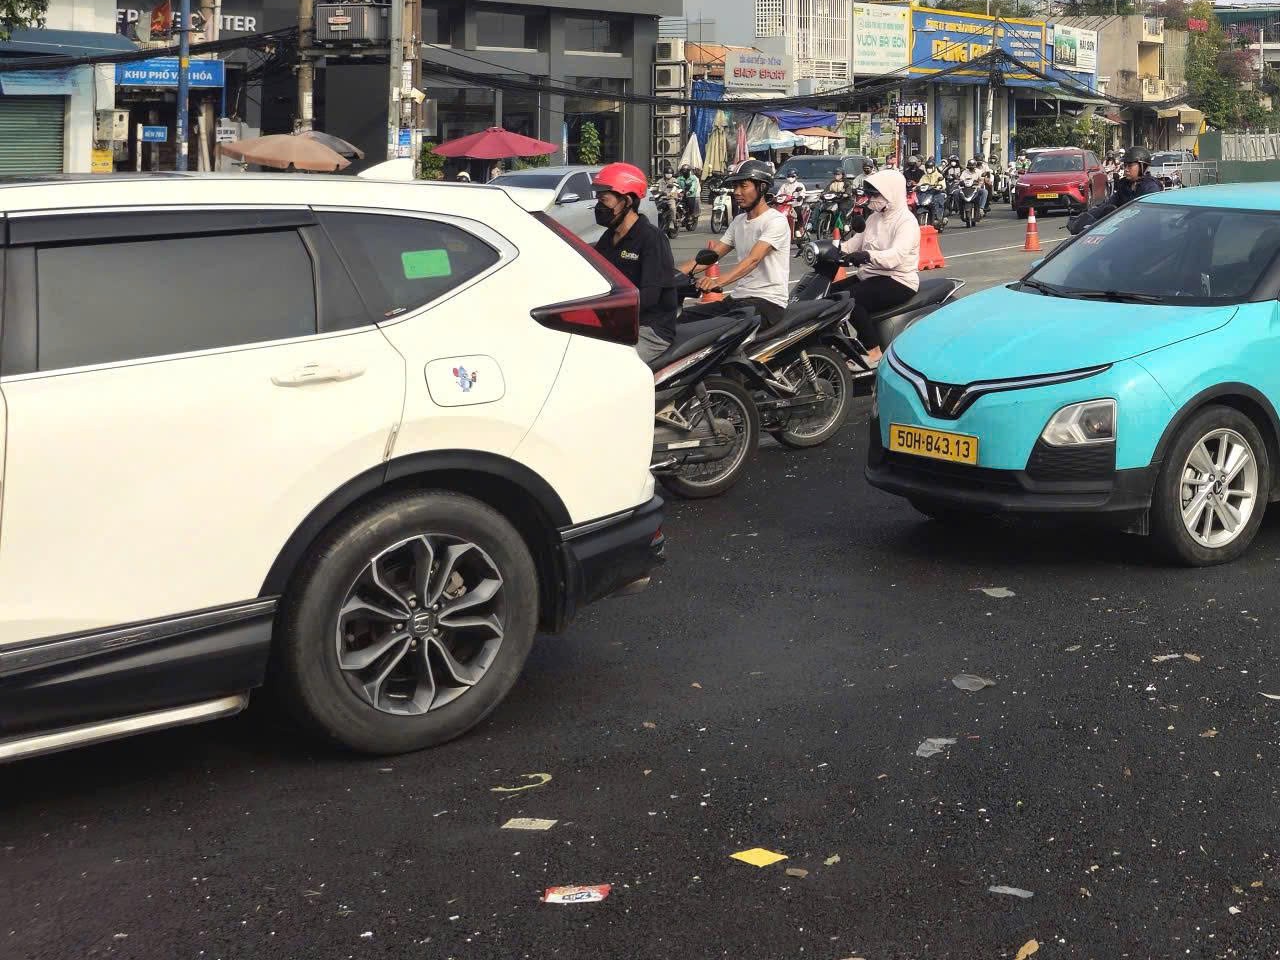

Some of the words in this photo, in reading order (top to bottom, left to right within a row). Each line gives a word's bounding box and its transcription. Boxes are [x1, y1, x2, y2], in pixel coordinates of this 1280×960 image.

[191, 13, 256, 31] CTER
[124, 70, 147, 79] KHU
[149, 68, 170, 80] PHỐ
[192, 71, 213, 81] HÓA
[897, 104, 924, 117] SOFA
[897, 429, 970, 458] 50H-843.13
